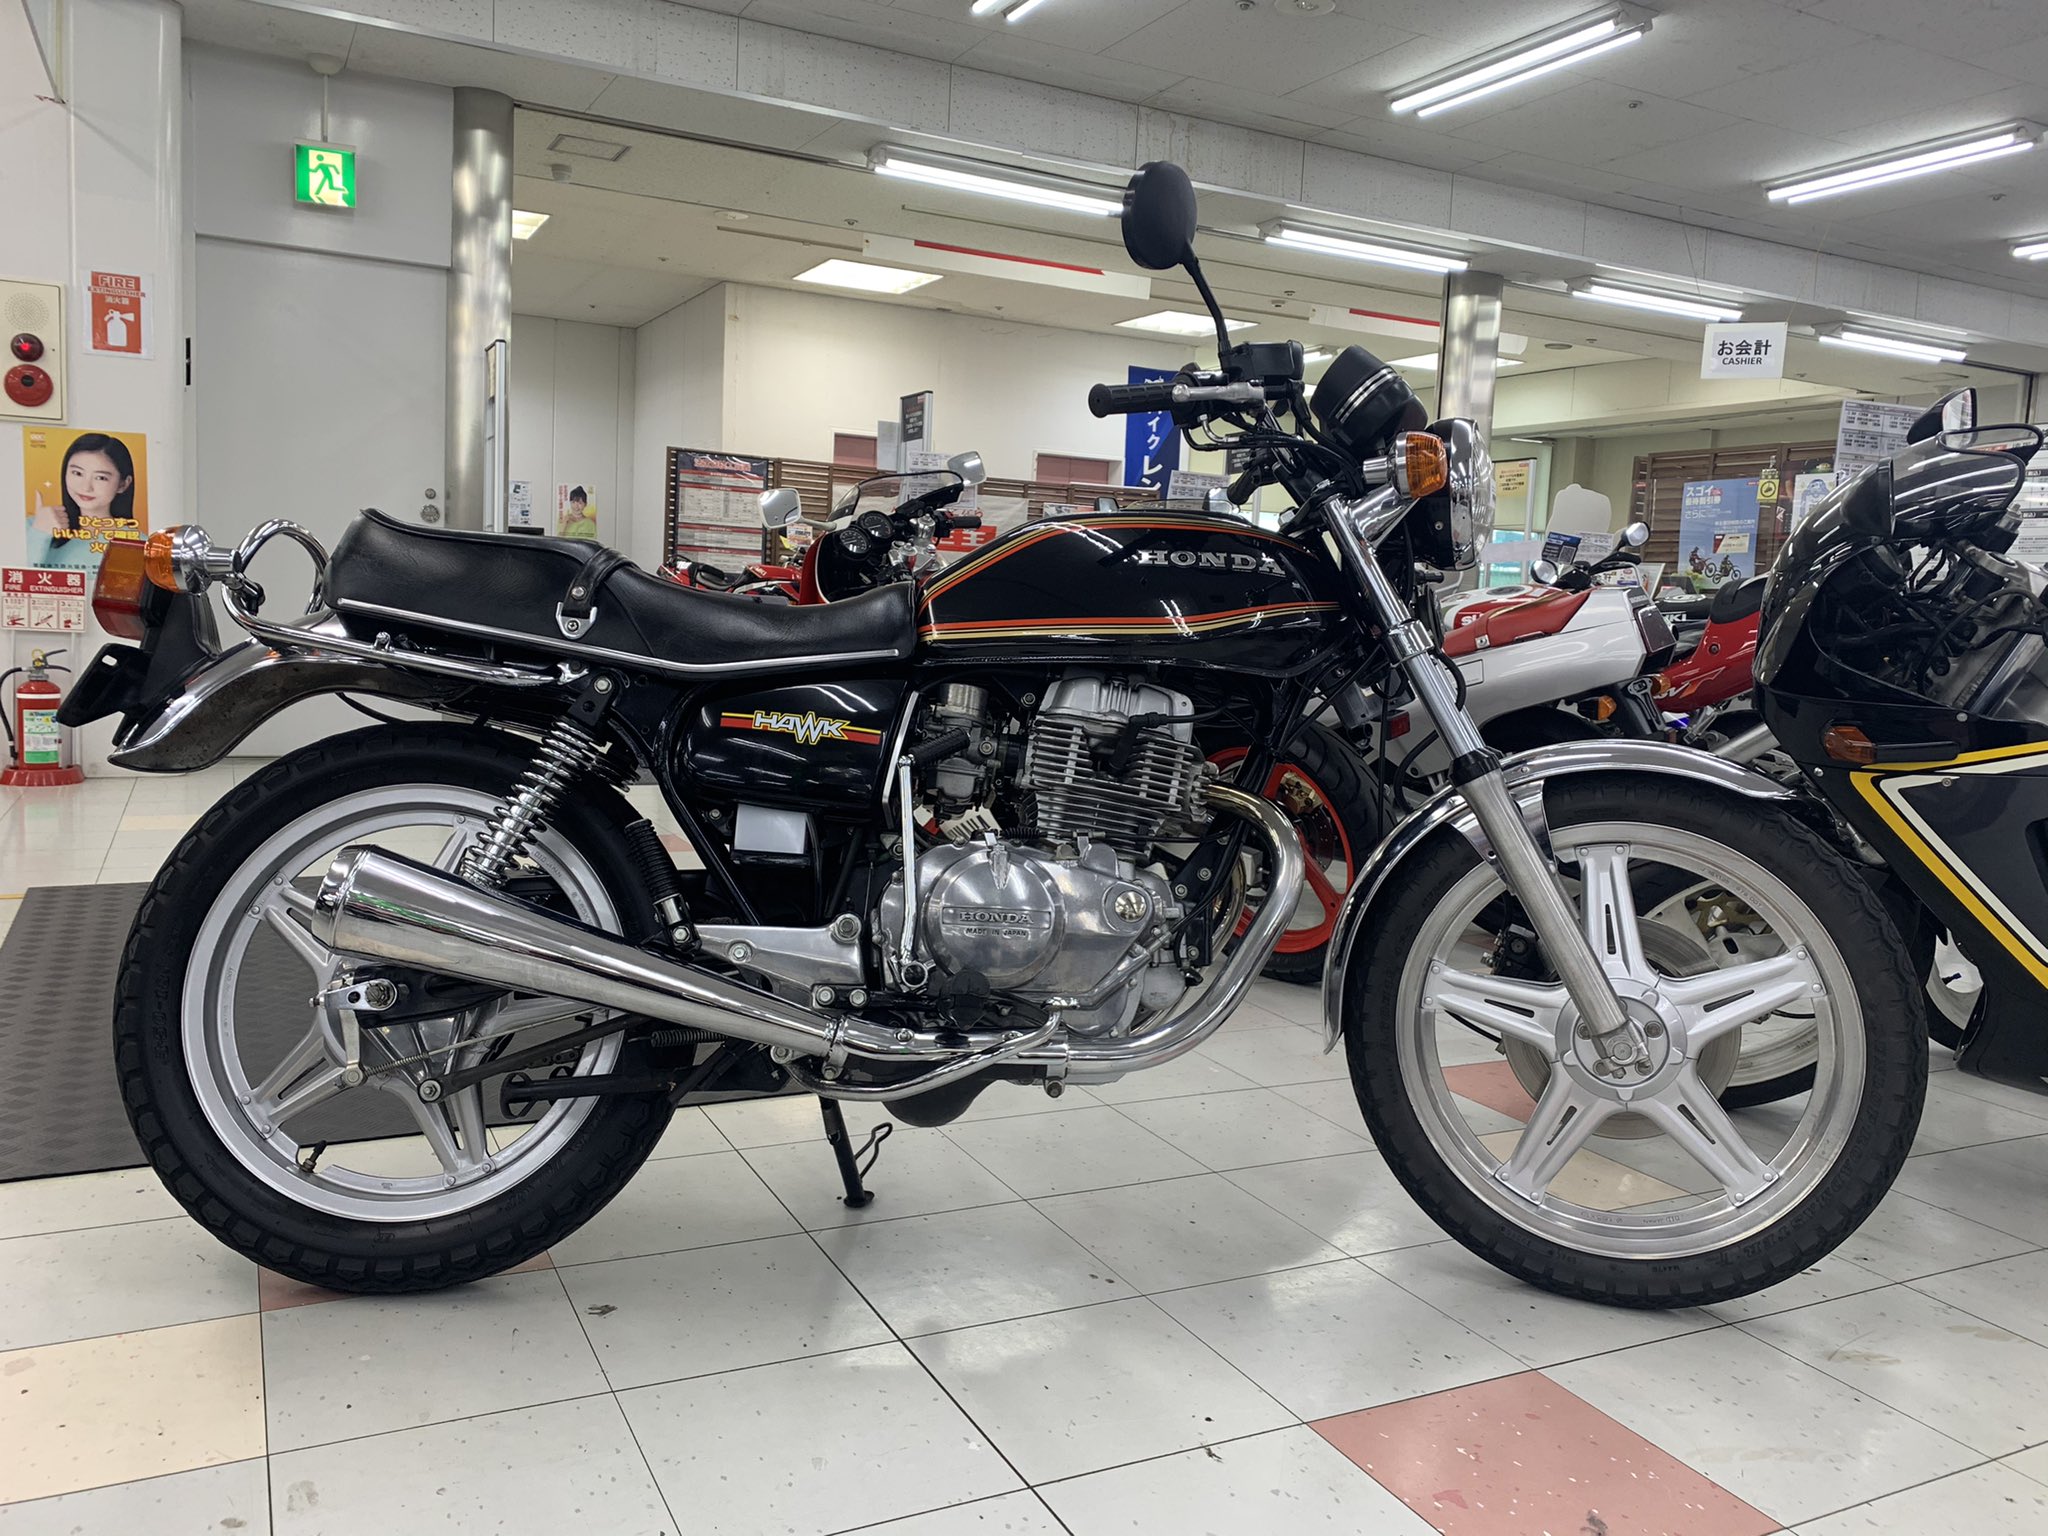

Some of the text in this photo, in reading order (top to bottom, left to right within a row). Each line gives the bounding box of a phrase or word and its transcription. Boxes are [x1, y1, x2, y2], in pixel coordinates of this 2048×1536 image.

[98, 275, 135, 289] FIRE
[88, 285, 146, 298] EXTINGUISHER
[1717, 339, 1772, 356] お会計
[1722, 356, 1763, 365] CASHIER
[1686, 485, 1711, 496] スゴイ
[78, 516, 139, 528] ひとつずつ
[90, 542, 108, 553] 火
[1137, 549, 1287, 577] HONDA
[8, 570, 81, 587] 消火器
[4, 583, 84, 594] FIRE EXTINGUISHER
[753, 711, 848, 743] HAWK
[959, 911, 1034, 924] HONDA
[965, 927, 1028, 937] MADE IN JAPAN
